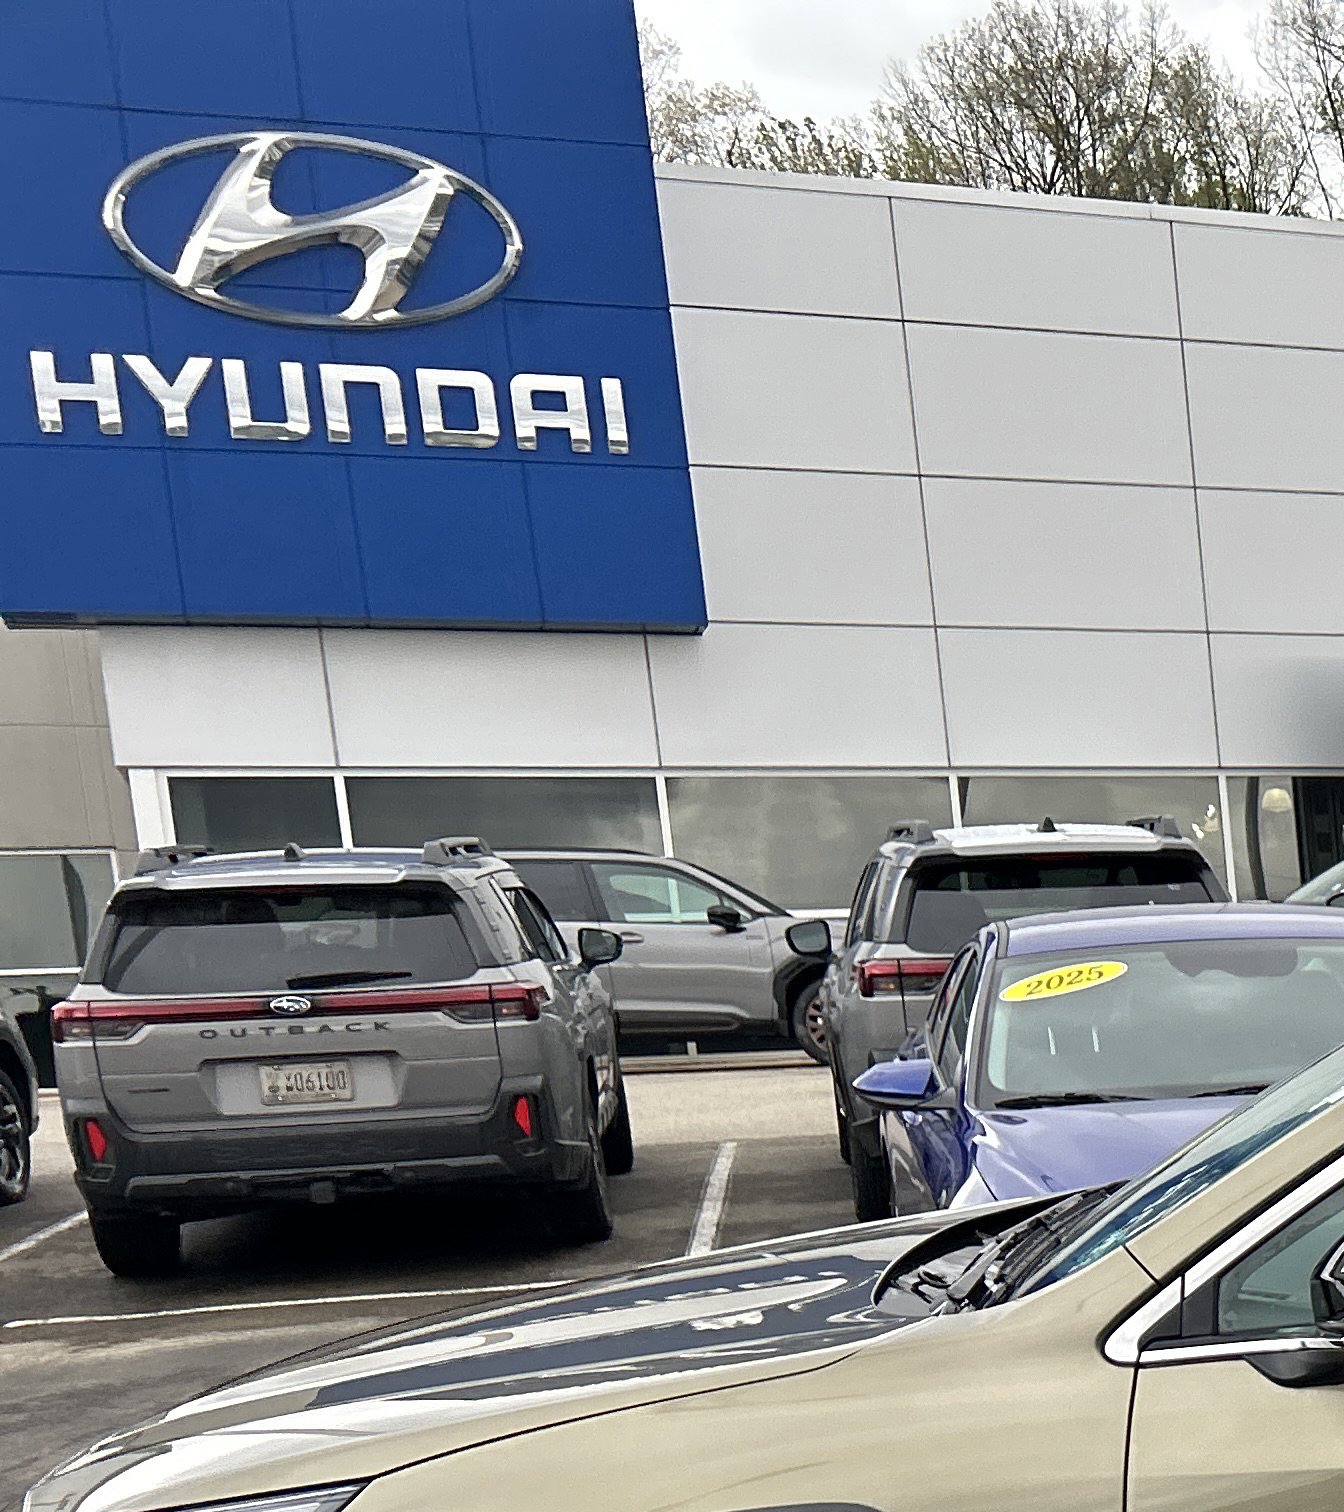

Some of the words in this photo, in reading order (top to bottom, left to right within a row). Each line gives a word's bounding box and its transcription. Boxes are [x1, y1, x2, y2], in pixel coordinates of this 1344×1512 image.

[30, 350, 629, 455] HYUNDAI
[1025, 965, 1104, 997] 2025
[199, 1021, 390, 1039] OUTBACK
